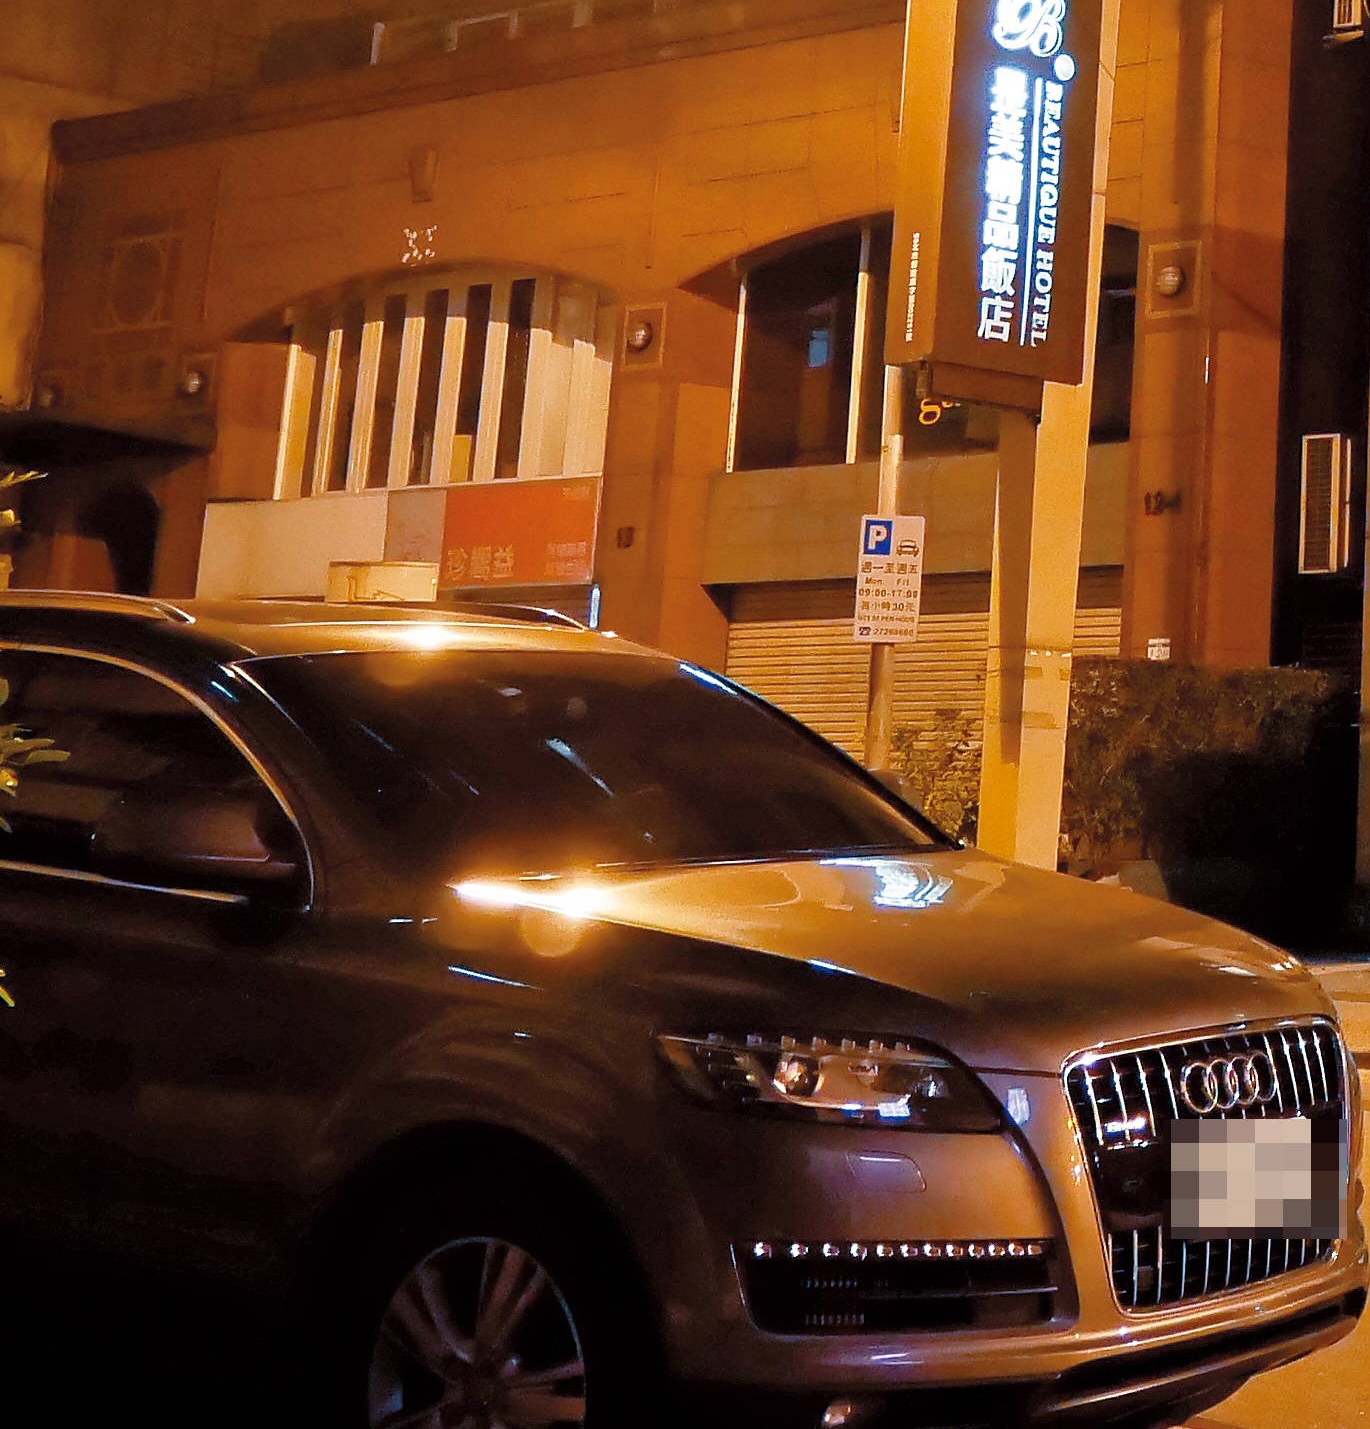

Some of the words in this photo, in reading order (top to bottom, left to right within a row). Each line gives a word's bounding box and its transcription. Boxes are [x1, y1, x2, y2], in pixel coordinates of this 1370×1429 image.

[1037, 82, 1063, 245] BEAUTIQUE
[1031, 249, 1054, 347] HOTEL
[868, 524, 888, 551] P
